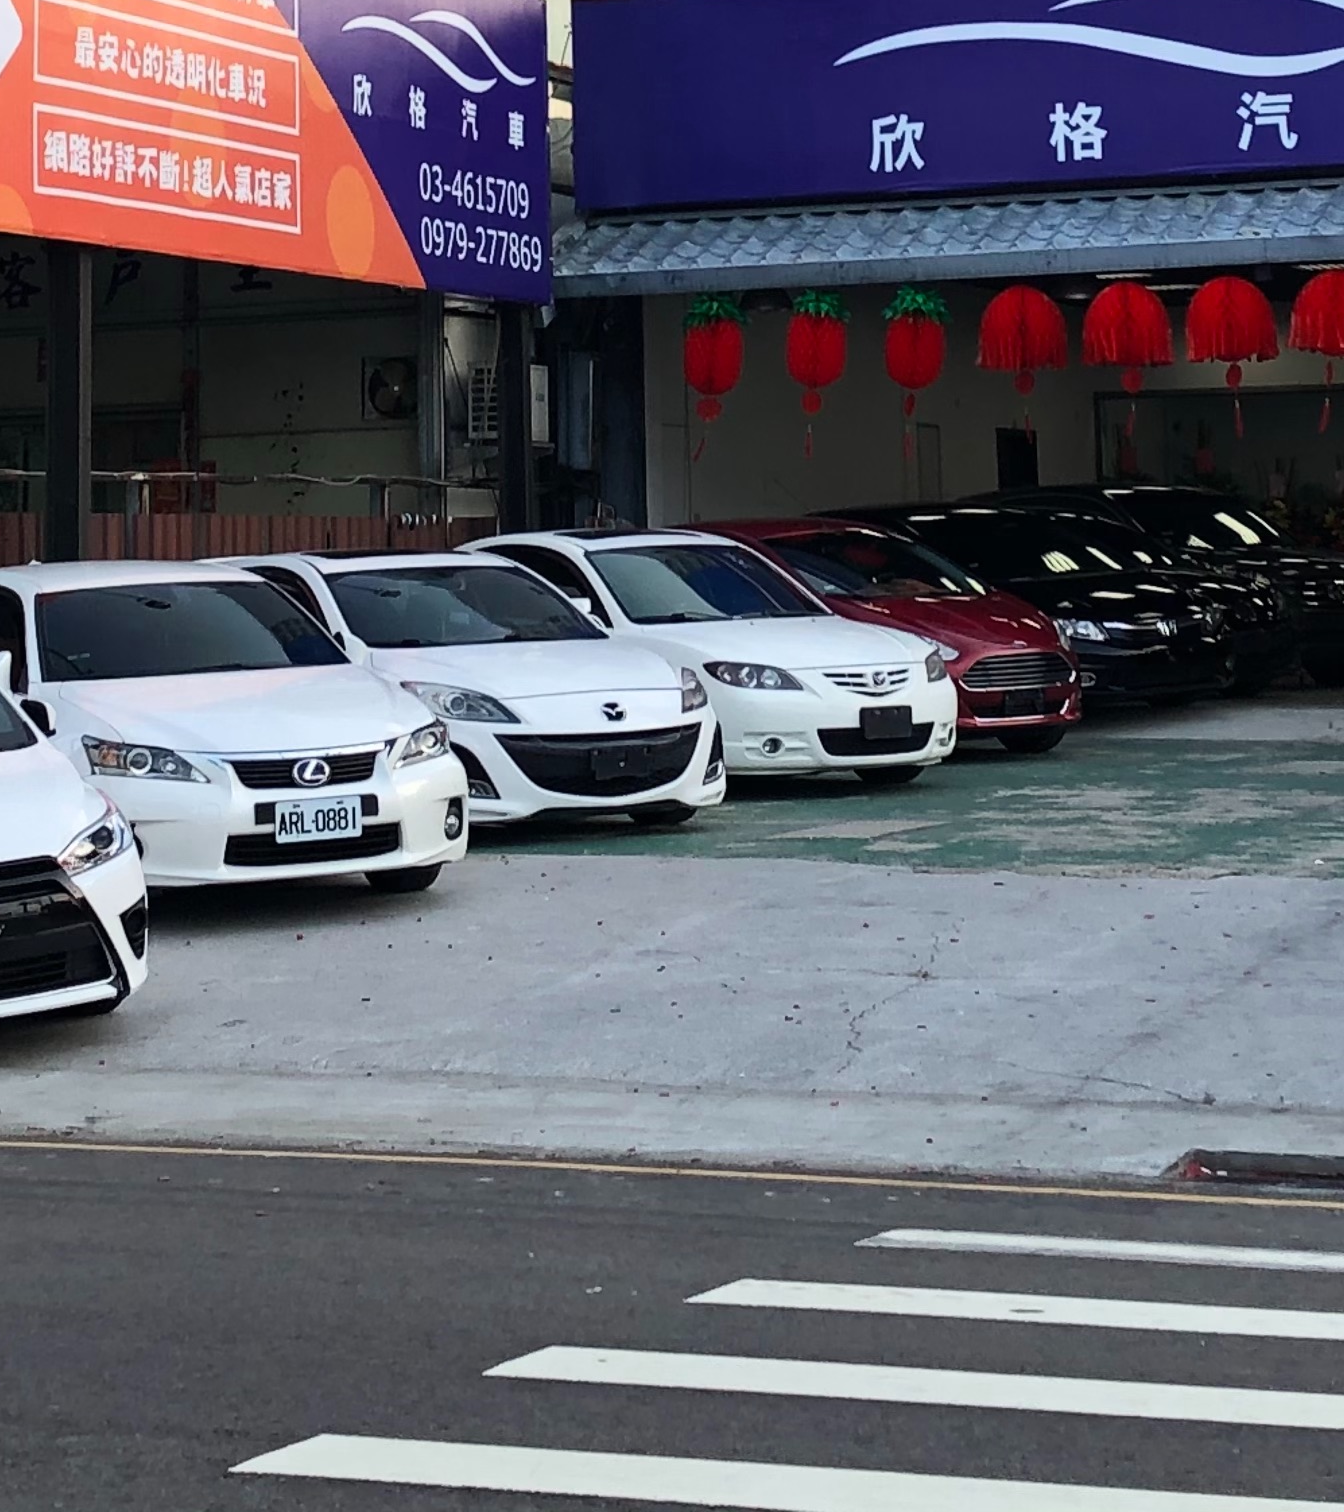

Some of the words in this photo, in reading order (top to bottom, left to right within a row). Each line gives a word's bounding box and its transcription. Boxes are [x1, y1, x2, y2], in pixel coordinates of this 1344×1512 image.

[73, 31, 268, 109] 最安心的透明化車況
[352, 74, 526, 150] 欣格汽車
[419, 162, 530, 220] 03-4615709
[420, 217, 543, 273] 0979-277869
[278, 806, 356, 836] ARL-0881
